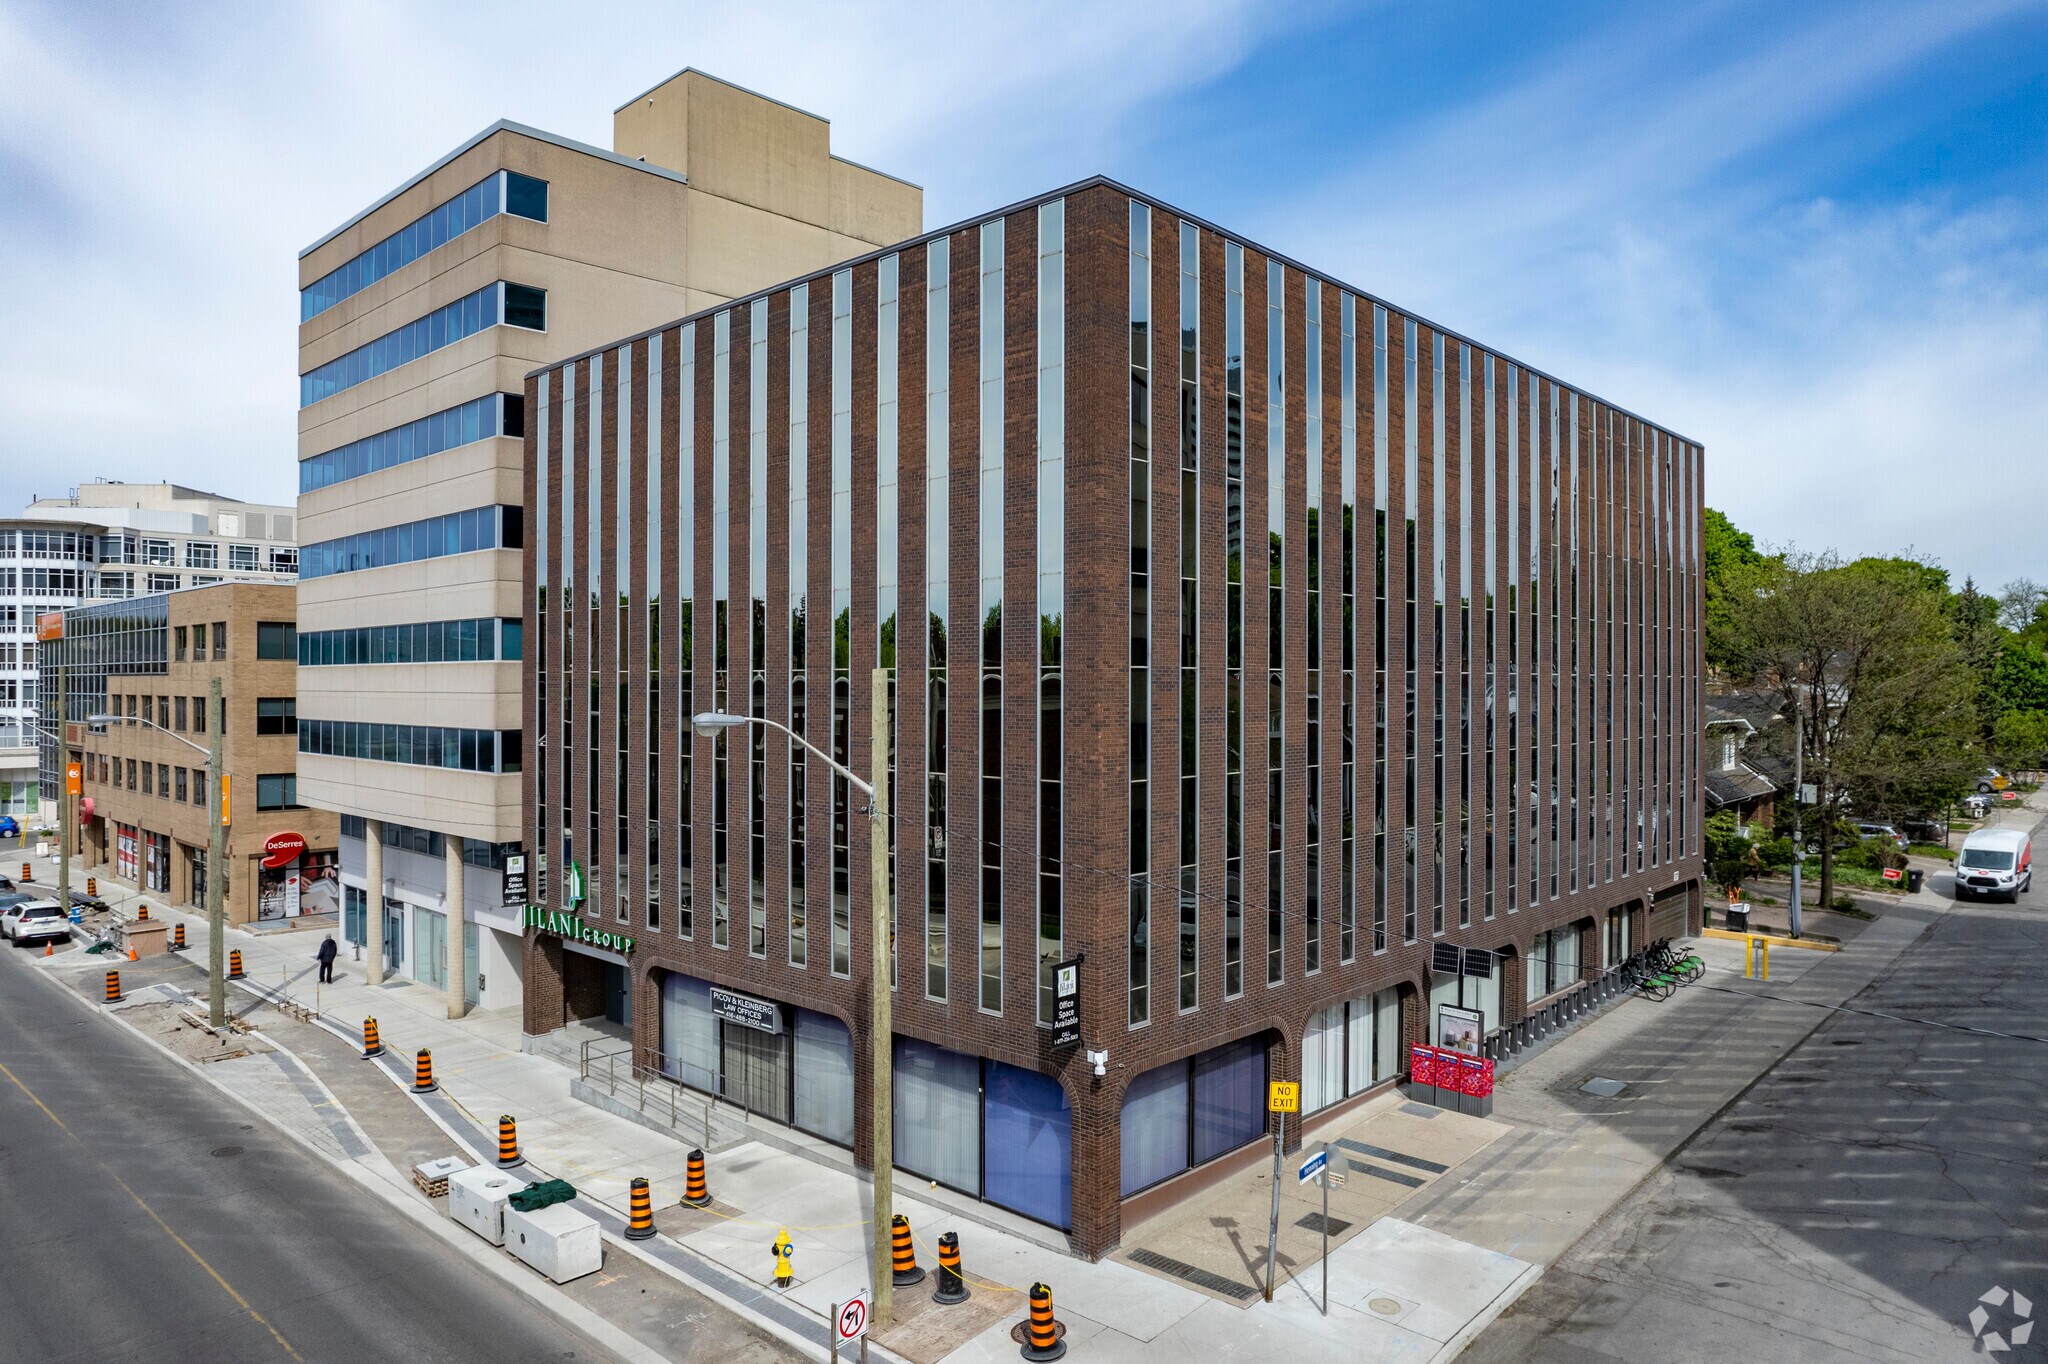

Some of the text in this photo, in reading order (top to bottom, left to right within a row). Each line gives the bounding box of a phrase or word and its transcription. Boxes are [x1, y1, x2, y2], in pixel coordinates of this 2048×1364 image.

[268, 840, 303, 850] DeSerres
[522, 903, 633, 953] JILANI GROUP
[713, 991, 773, 1015] PICOV & KLEINBERG
[1058, 1000, 1074, 1010] Office
[723, 1002, 762, 1020] LAW OFFICES
[1058, 1009, 1075, 1020] Space
[725, 1011, 760, 1027] 416-488-2100
[1054, 1016, 1079, 1029] Available
[1277, 1086, 1291, 1096] NO
[1273, 1098, 1294, 1108] EXIT
[1304, 1161, 1319, 1176] Henning
